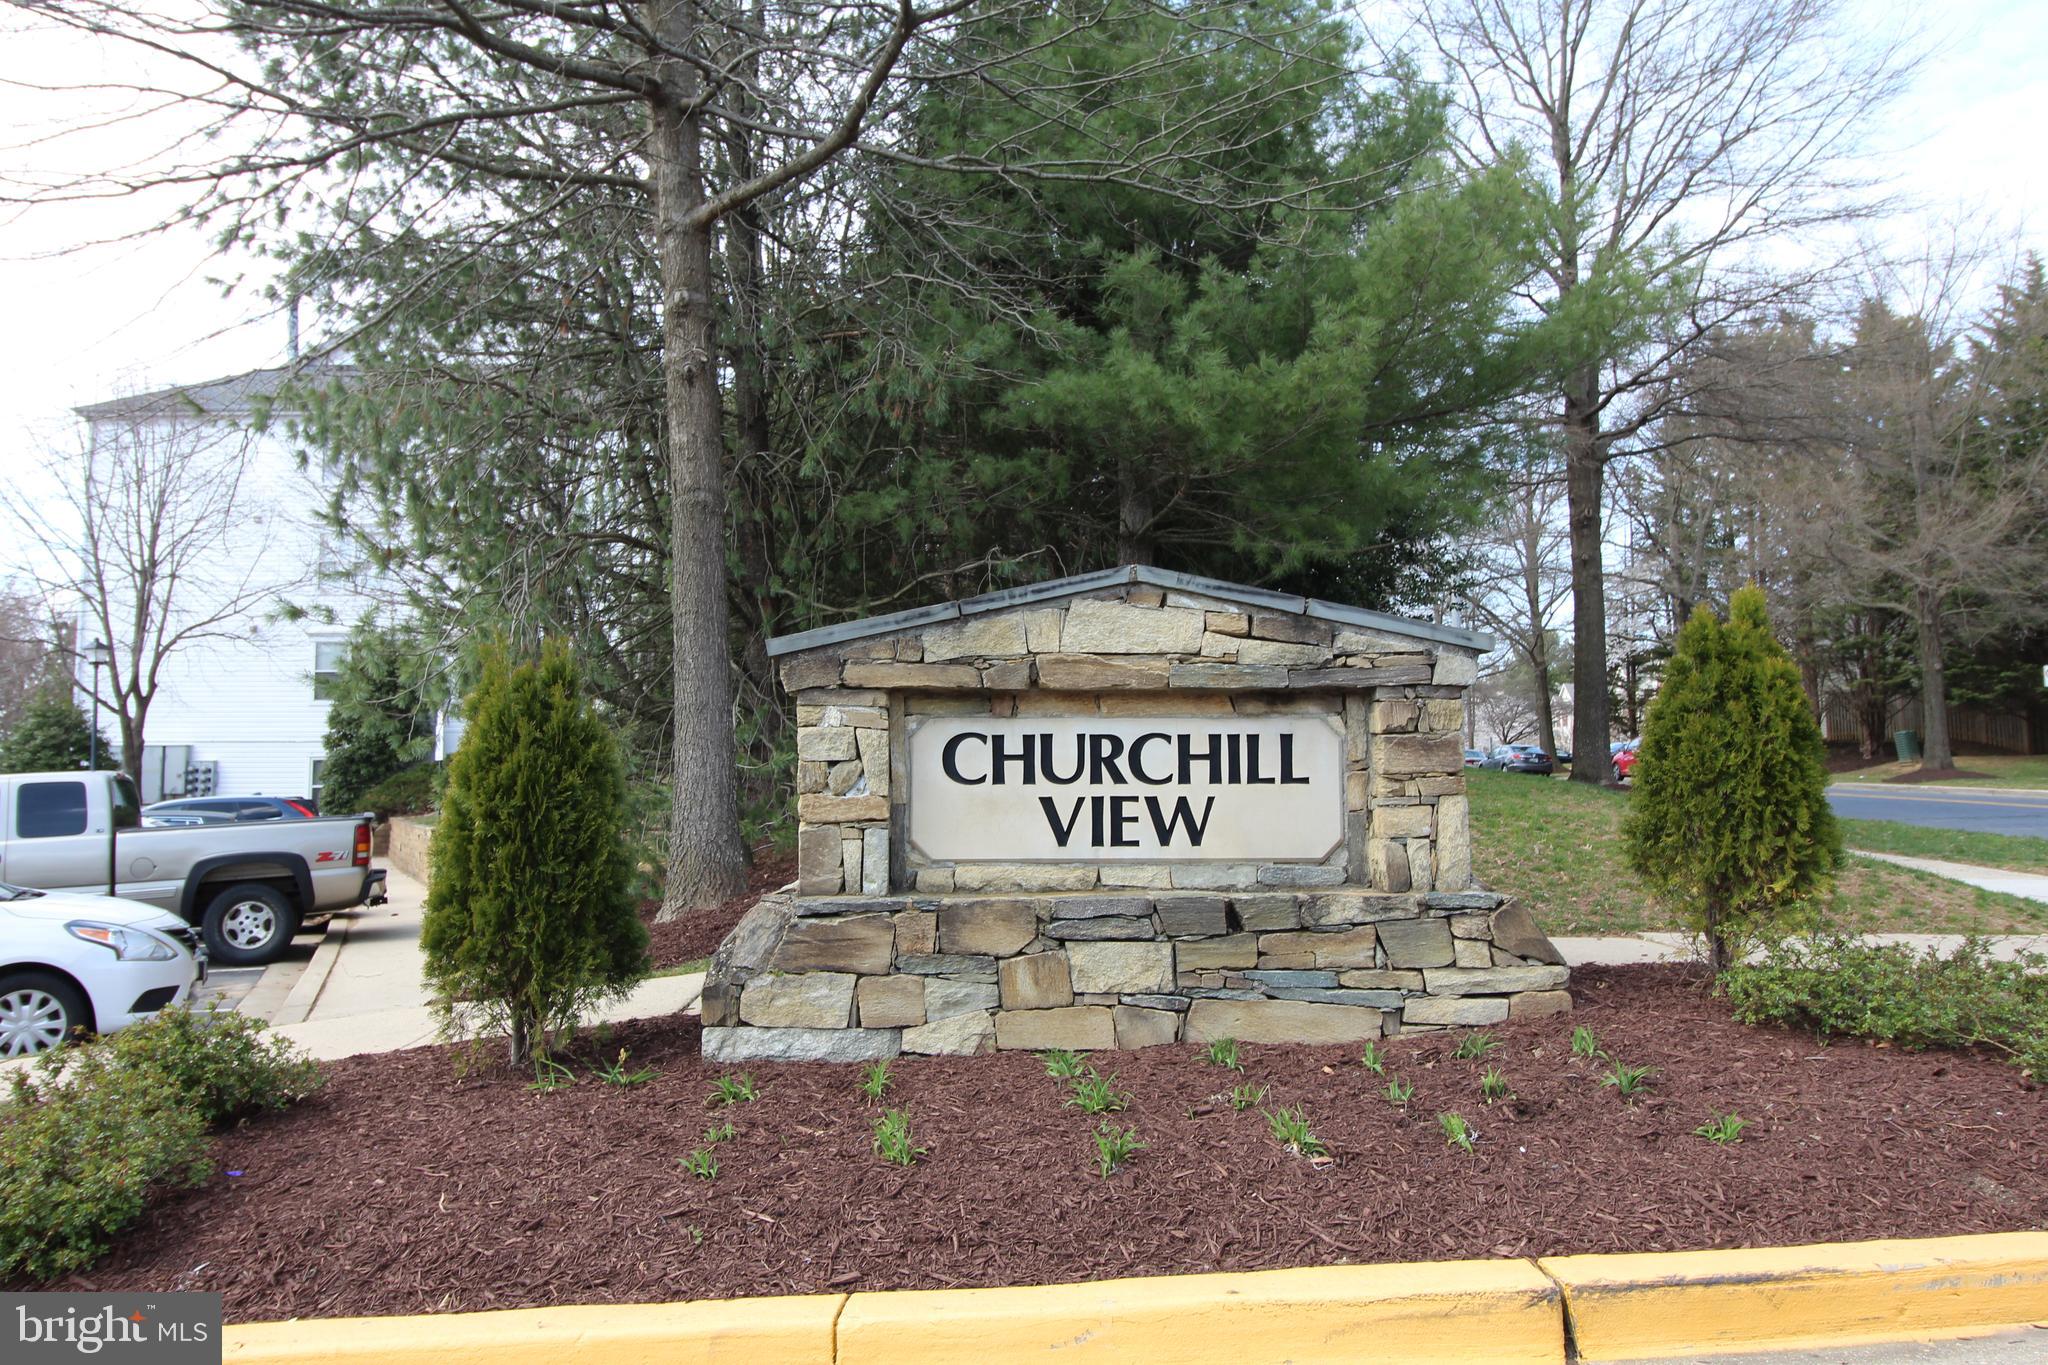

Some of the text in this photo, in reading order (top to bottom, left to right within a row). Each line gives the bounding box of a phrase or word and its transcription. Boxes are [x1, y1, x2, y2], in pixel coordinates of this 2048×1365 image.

[942, 732, 1309, 785] CHURCHILL
[1038, 796, 1215, 847] VIEW
[315, 850, 349, 863] Z71
